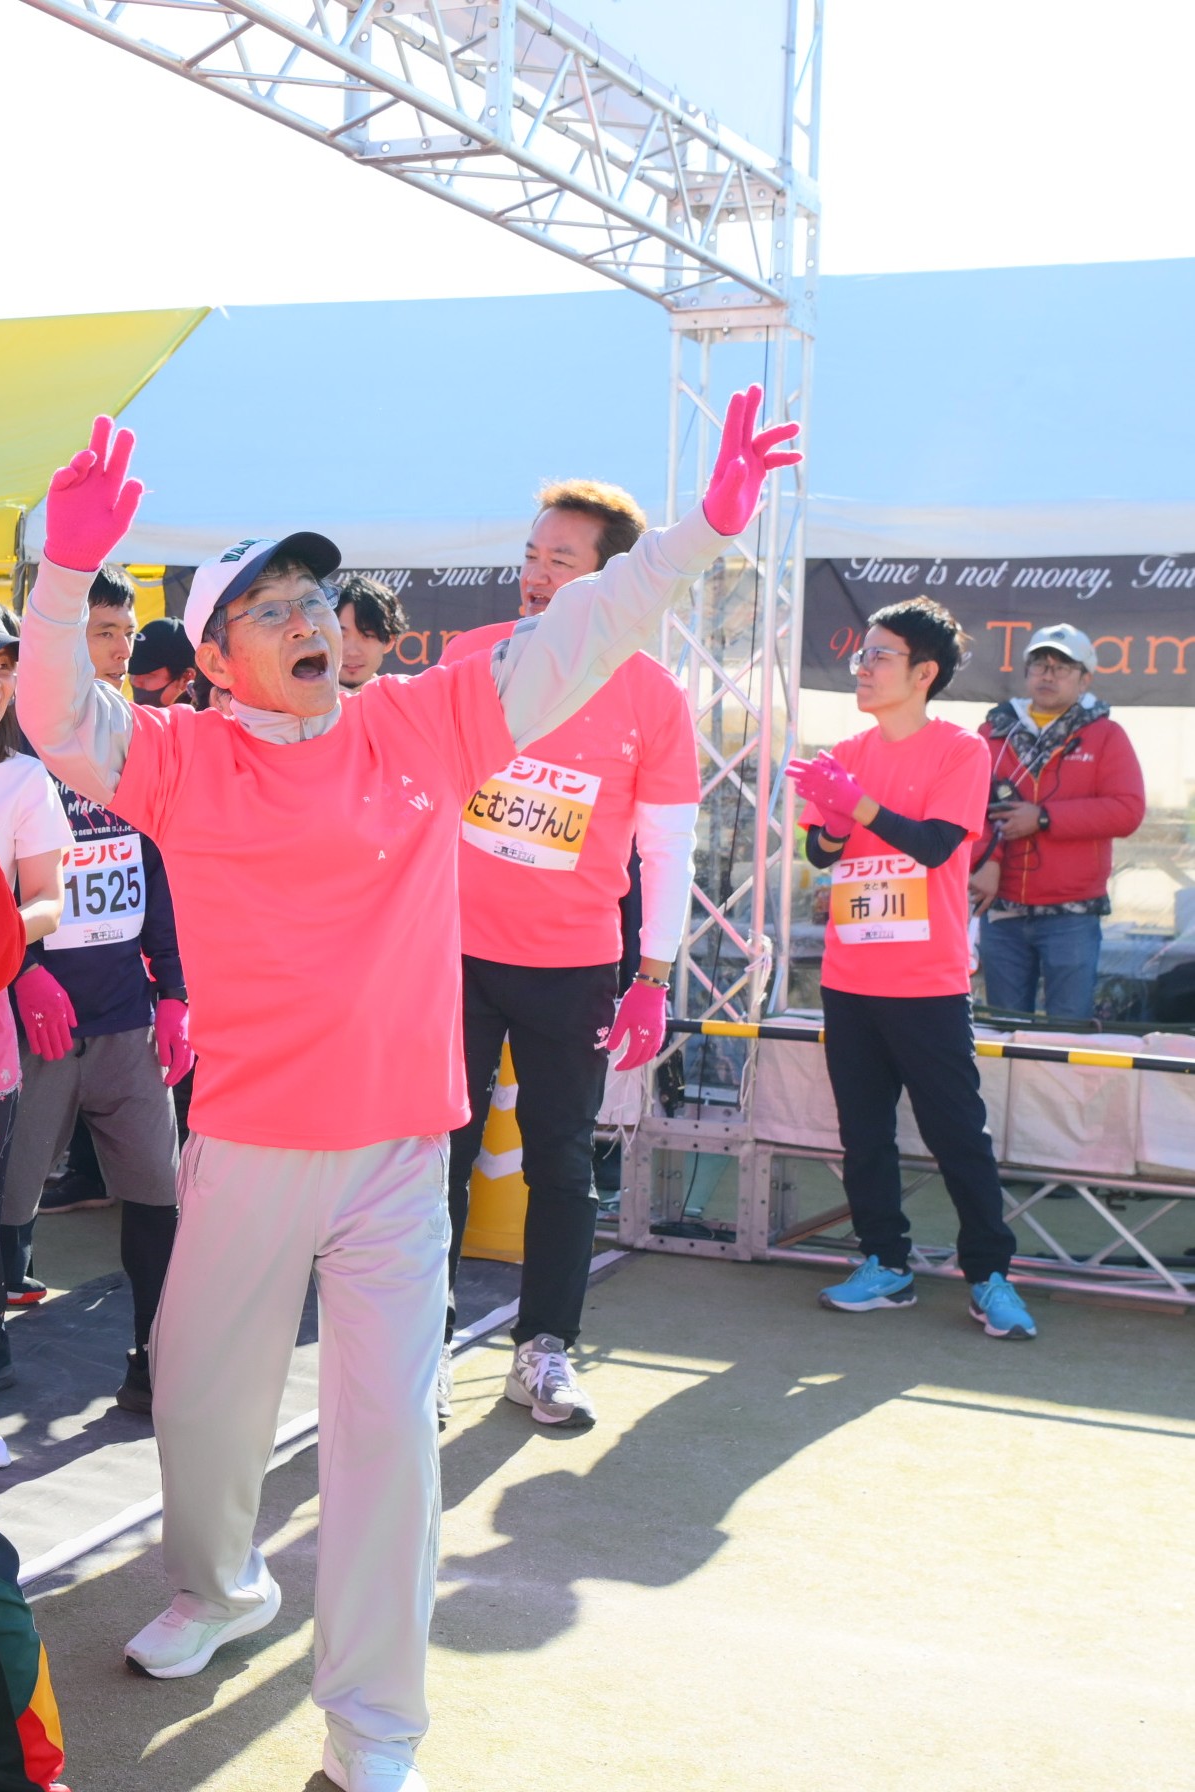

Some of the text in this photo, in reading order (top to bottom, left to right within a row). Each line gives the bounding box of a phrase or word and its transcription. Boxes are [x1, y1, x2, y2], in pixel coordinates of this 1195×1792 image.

[844, 557, 920, 585] Time
[925, 558, 948, 586] is
[955, 560, 1009, 588] not
[1011, 567, 1113, 600] money.
[986, 621, 1195, 675] Tam
[840, 858, 916, 879] フジパン
[64, 866, 141, 917] 1525
[849, 893, 905, 919] 市川
